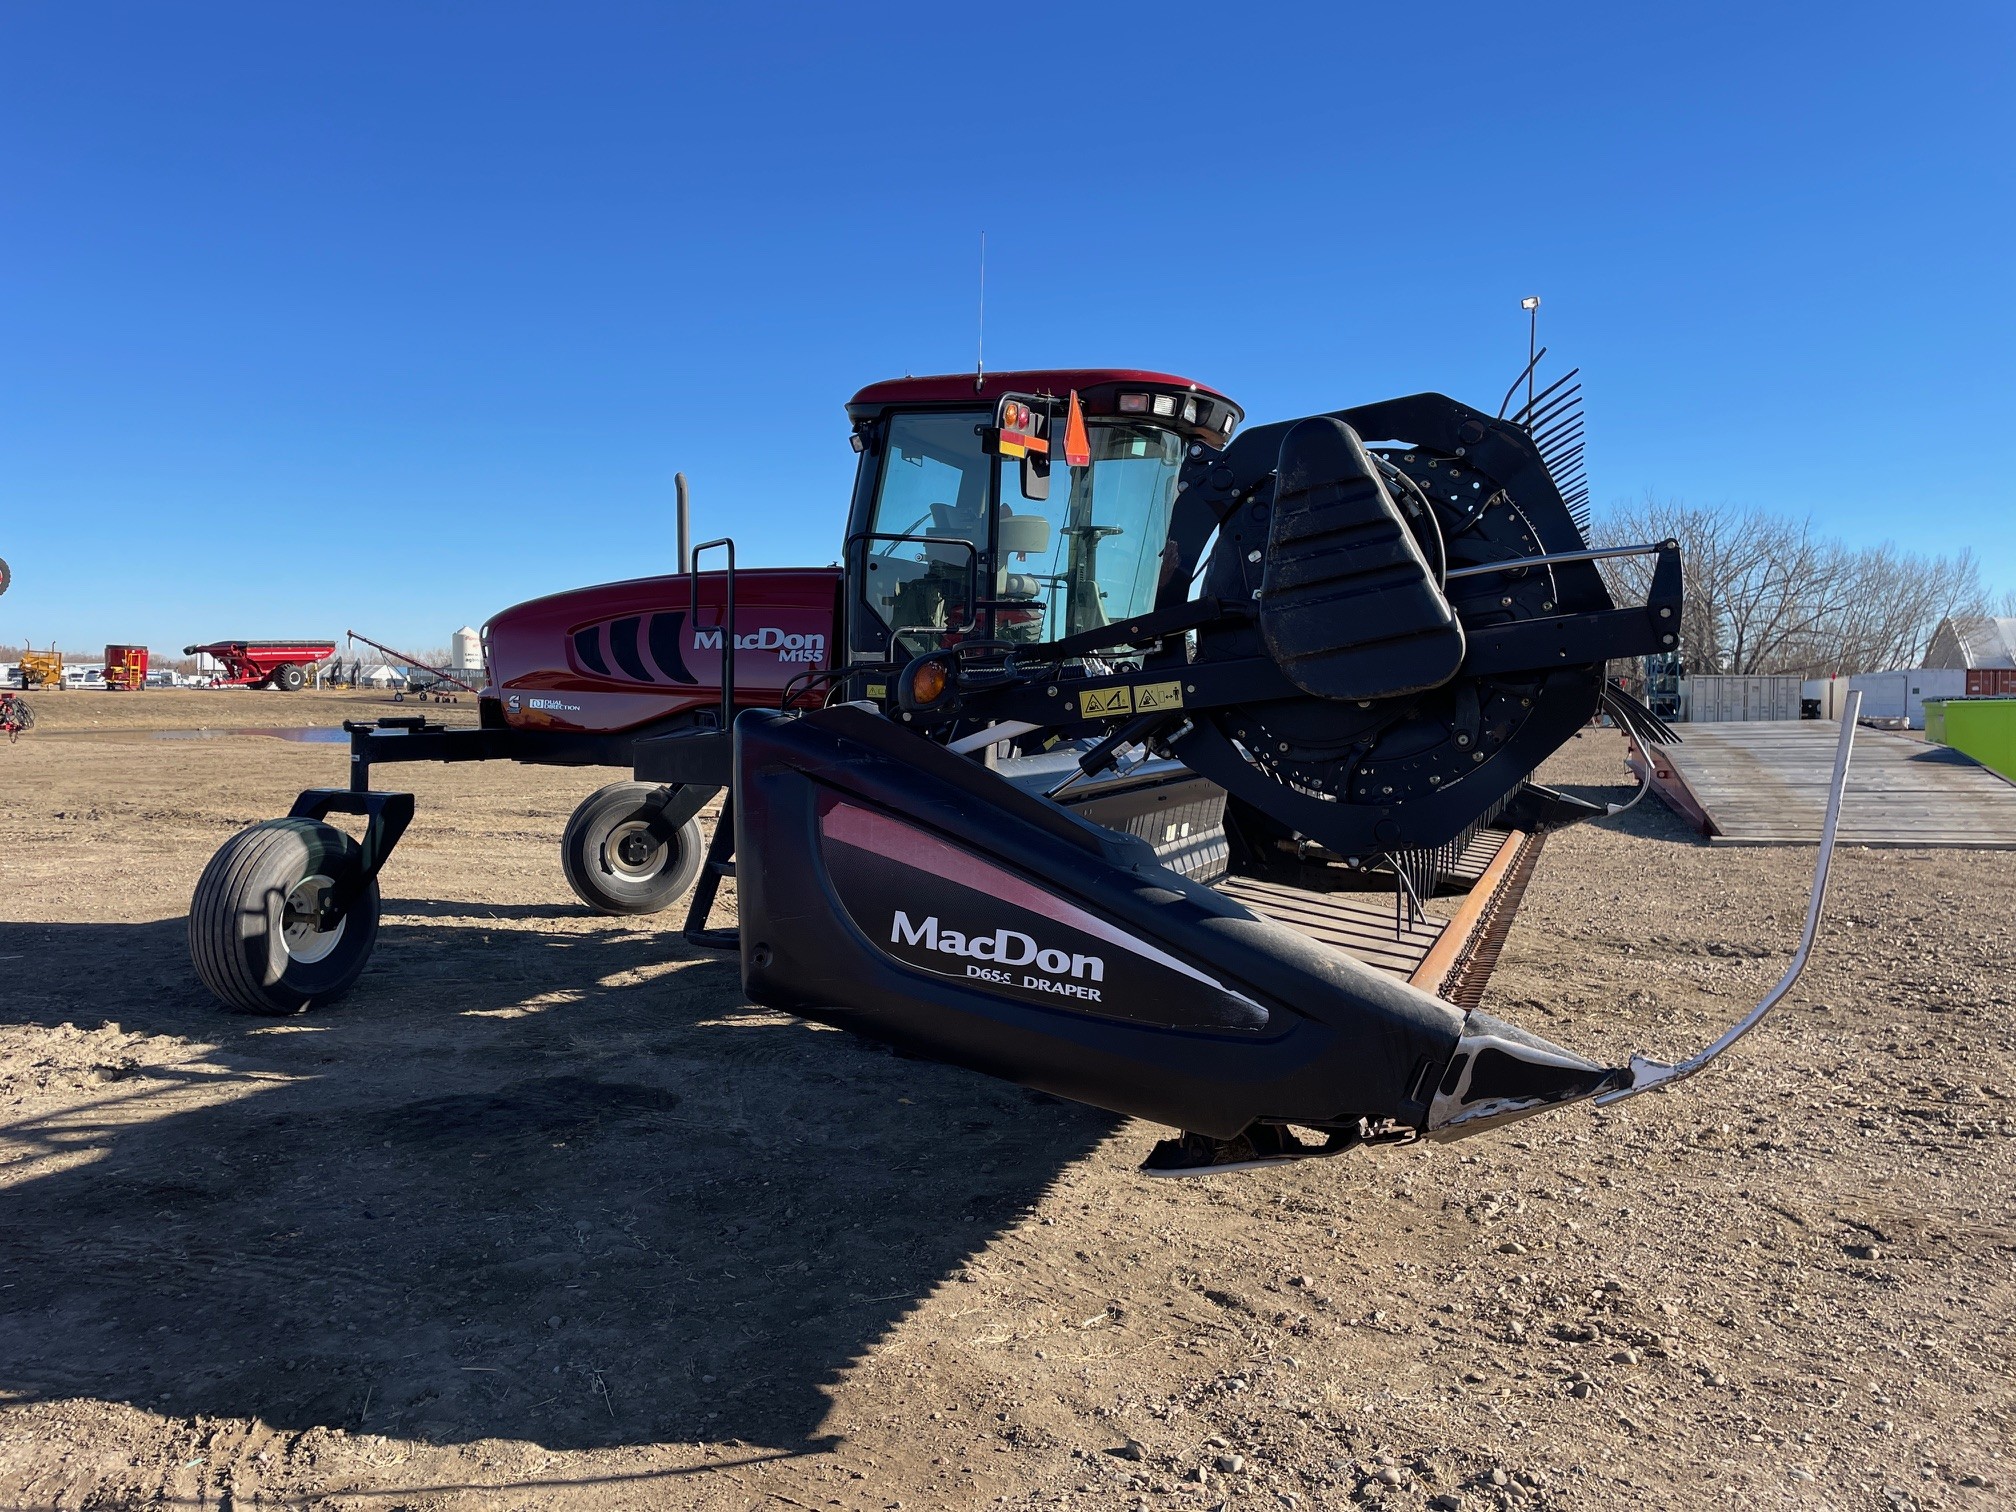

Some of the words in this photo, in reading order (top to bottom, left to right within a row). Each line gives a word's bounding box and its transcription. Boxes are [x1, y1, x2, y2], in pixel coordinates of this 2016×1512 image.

[778, 650, 823, 663] M155
[544, 703, 581, 711] DIRECTION
[890, 910, 1105, 982] MacDon
[1023, 975, 1102, 1003] DRAPER
